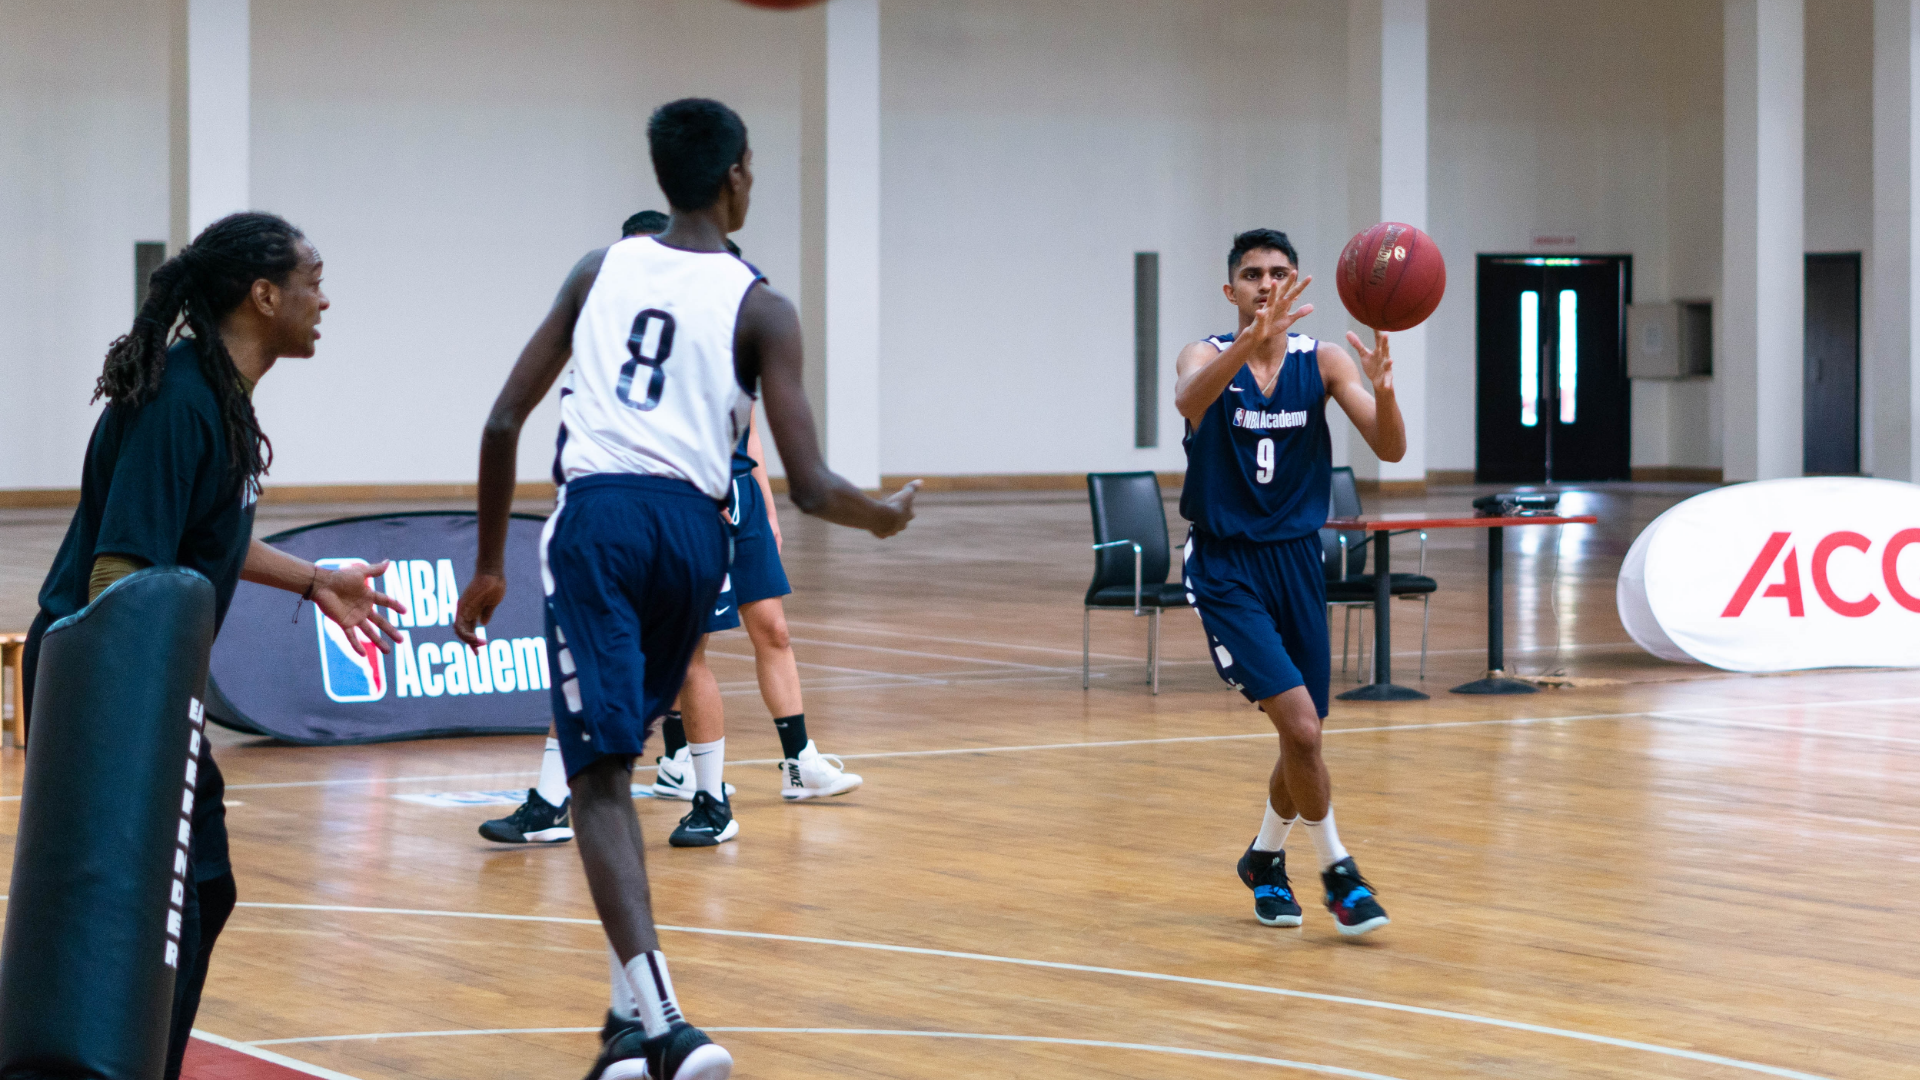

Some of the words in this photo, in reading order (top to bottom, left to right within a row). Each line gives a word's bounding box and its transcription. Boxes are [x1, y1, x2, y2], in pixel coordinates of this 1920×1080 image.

[616, 308, 676, 412] 8
[1260, 409, 1307, 428] Academy
[1256, 438, 1275, 484] 9
[383, 558, 459, 627] NBA
[394, 626, 551, 698] Academ
[788, 762, 804, 788] NIKE
